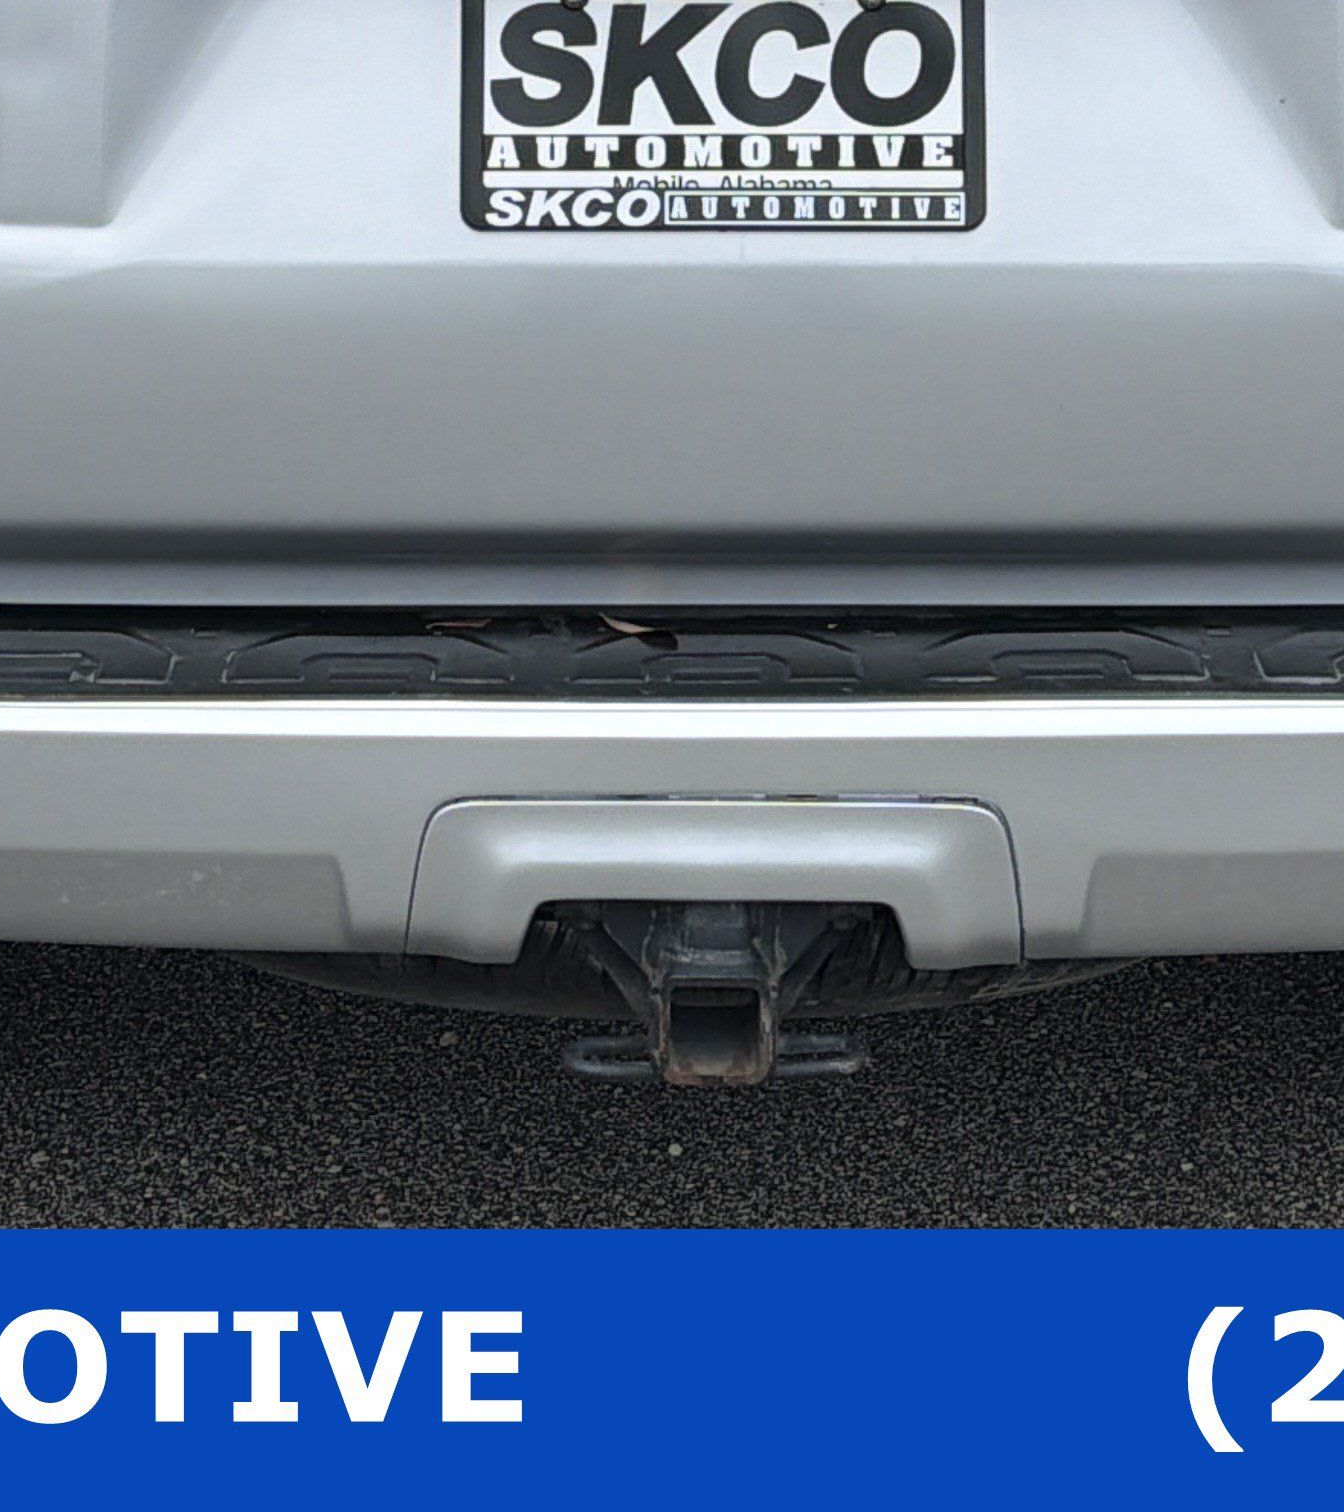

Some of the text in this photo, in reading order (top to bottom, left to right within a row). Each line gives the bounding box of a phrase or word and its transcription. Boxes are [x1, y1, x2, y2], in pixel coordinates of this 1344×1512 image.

[490, 0, 957, 127] SKCO
[487, 135, 954, 169] AUTOMOTIVE
[485, 188, 962, 227] SKCO AUTOMOTIVE
